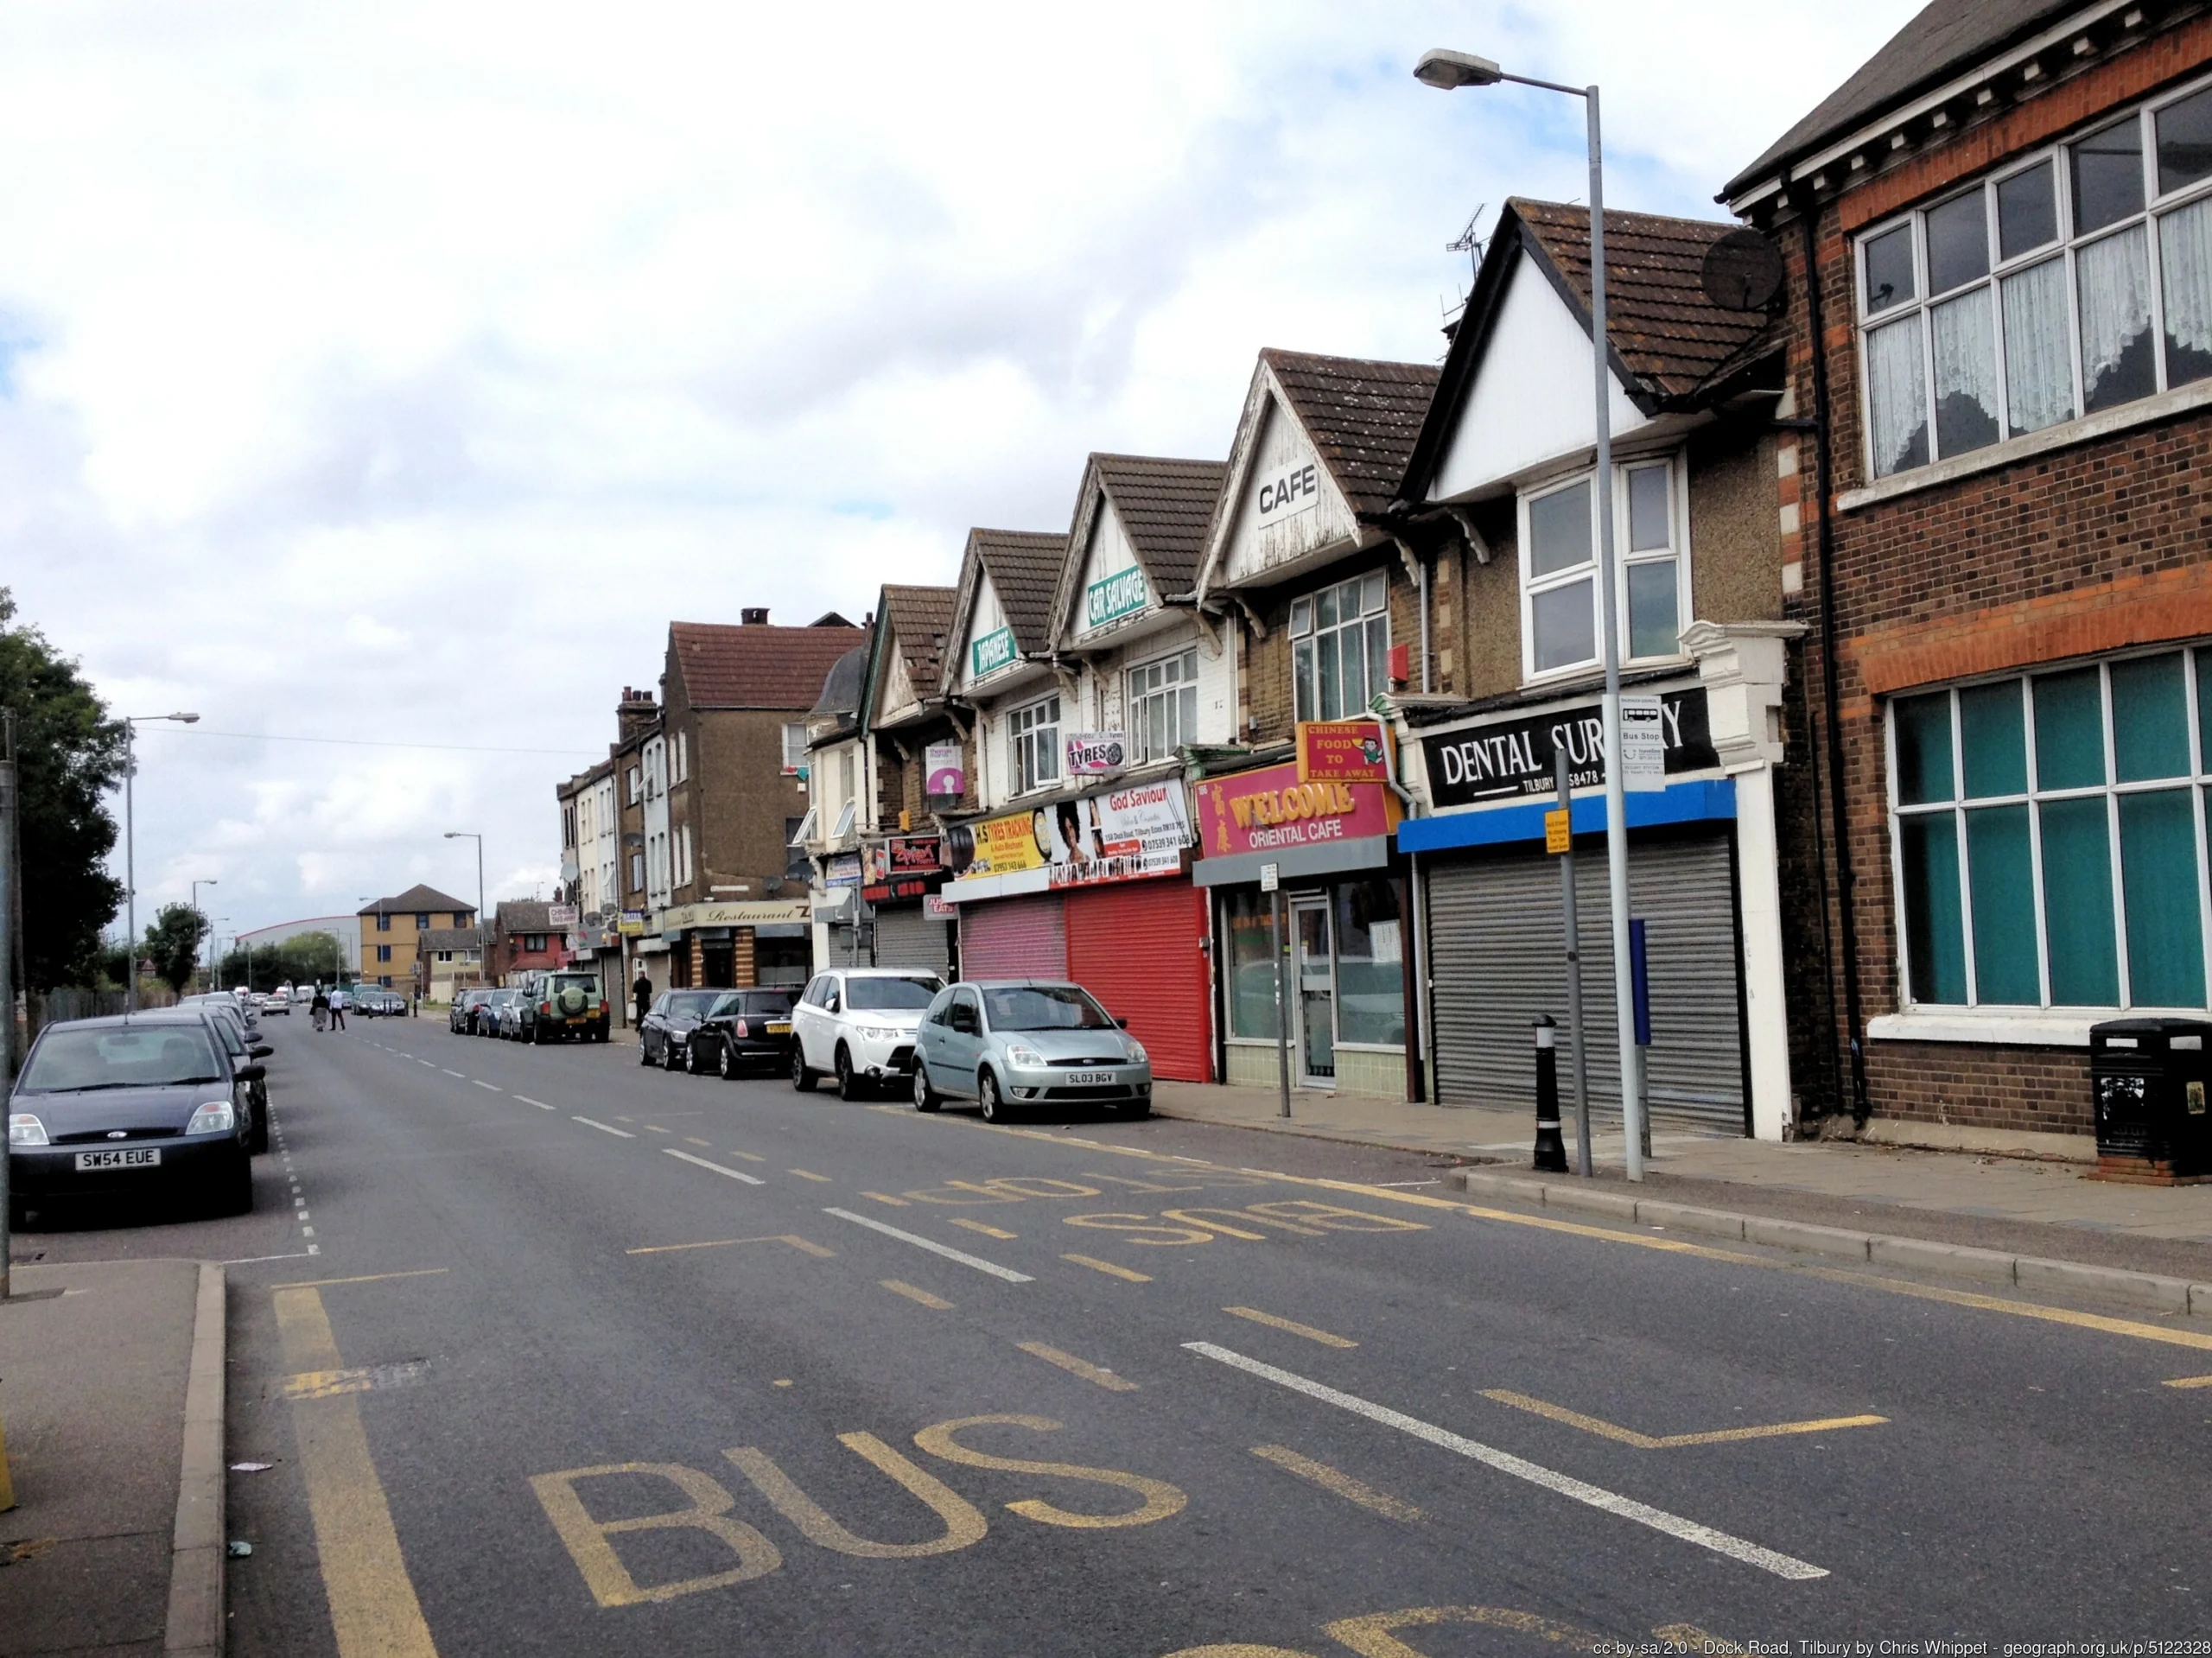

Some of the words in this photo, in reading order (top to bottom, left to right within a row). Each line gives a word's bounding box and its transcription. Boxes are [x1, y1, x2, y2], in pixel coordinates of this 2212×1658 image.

[1260, 464, 1315, 514] CAFE
[1089, 587, 1106, 623] CAR
[1106, 569, 1144, 614] SALVAGE
[977, 629, 1010, 674] JAPANESE
[1307, 726, 1358, 734] CHINESE
[1641, 732, 1660, 741] Stop
[1316, 740, 1352, 749] FOOD
[1440, 730, 1542, 785] DENTAL
[1551, 700, 1682, 765] SURY
[1070, 744, 1106, 765] TYRES
[1325, 754, 1344, 765] TO
[1310, 769, 1340, 778] TAKE
[1344, 769, 1376, 778] AWAY
[1522, 776, 1554, 793] TILBURY
[1109, 794, 1128, 811] God
[1131, 787, 1167, 807] Saviour
[1229, 783, 1355, 829] WELCOME
[975, 825, 988, 845] H.S
[988, 822, 1005, 842] TYRES
[1147, 837, 1166, 850] 07539
[1166, 835, 1177, 847] 341
[1249, 825, 1306, 848] ORIENTAL
[1308, 819, 1343, 841] CAFE
[928, 898, 944, 906] JUS
[706, 908, 794, 922] Restaurant
[1069, 1073, 1093, 1083] SL03
[1096, 1073, 1112, 1083] BGV
[83, 1153, 121, 1166] SW54
[126, 1150, 154, 1164] EUE
[1061, 1200, 1434, 1246] BUS
[529, 1413, 1187, 1608] BUS
